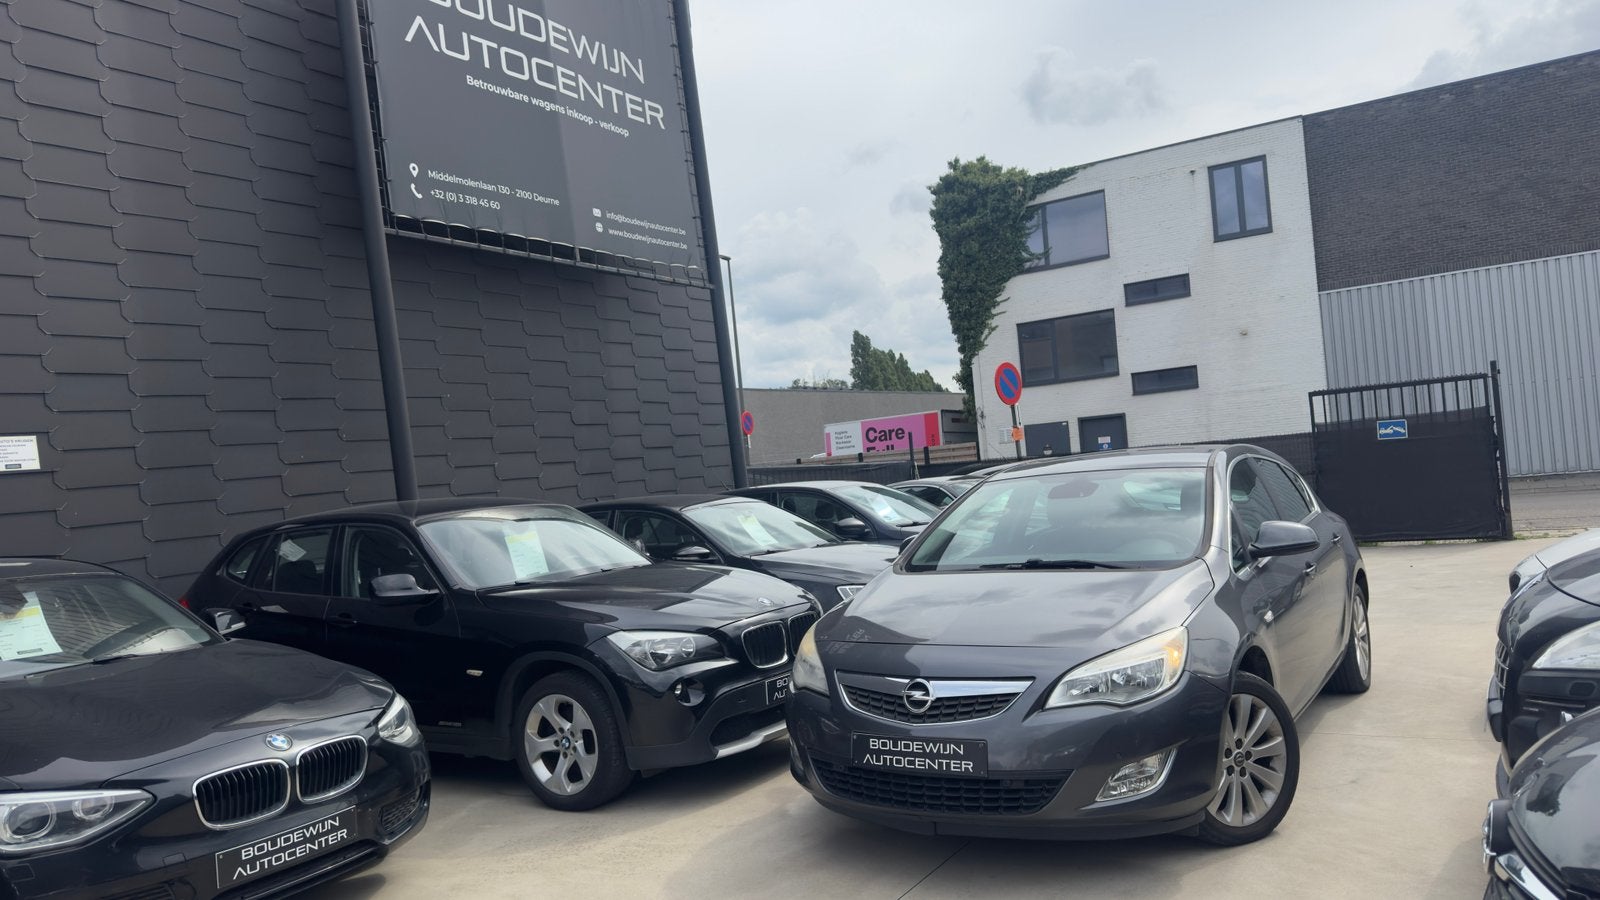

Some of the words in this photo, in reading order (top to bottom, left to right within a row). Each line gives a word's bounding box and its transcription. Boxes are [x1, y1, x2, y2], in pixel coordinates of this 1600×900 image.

[428, 0, 645, 84] OUDEWIJN
[404, 15, 666, 129] AUTOCENTER
[466, 75, 530, 103] Betrouwbare
[530, 96, 566, 115] wagens
[566, 106, 594, 126] inkoop
[599, 120, 629, 138] verkoop
[427, 170, 497, 192] Middelmolenlaan
[498, 184, 511, 196] 130
[516, 189, 533, 200] 2100
[533, 193, 560, 206] Deurne
[430, 189, 445, 200] +32
[446, 191, 457, 203] (0)
[458, 194, 464, 202] 3
[465, 195, 478, 206] 318
[479, 198, 489, 208] 45
[490, 200, 500, 210] 60
[865, 426, 905, 443] Care
[863, 753, 974, 773] AUTOCENTER
[869, 738, 964, 755] BOUDEWIJN
[232, 828, 348, 880] AUTOCENTER
[241, 816, 340, 861] BOUDEWIJN
